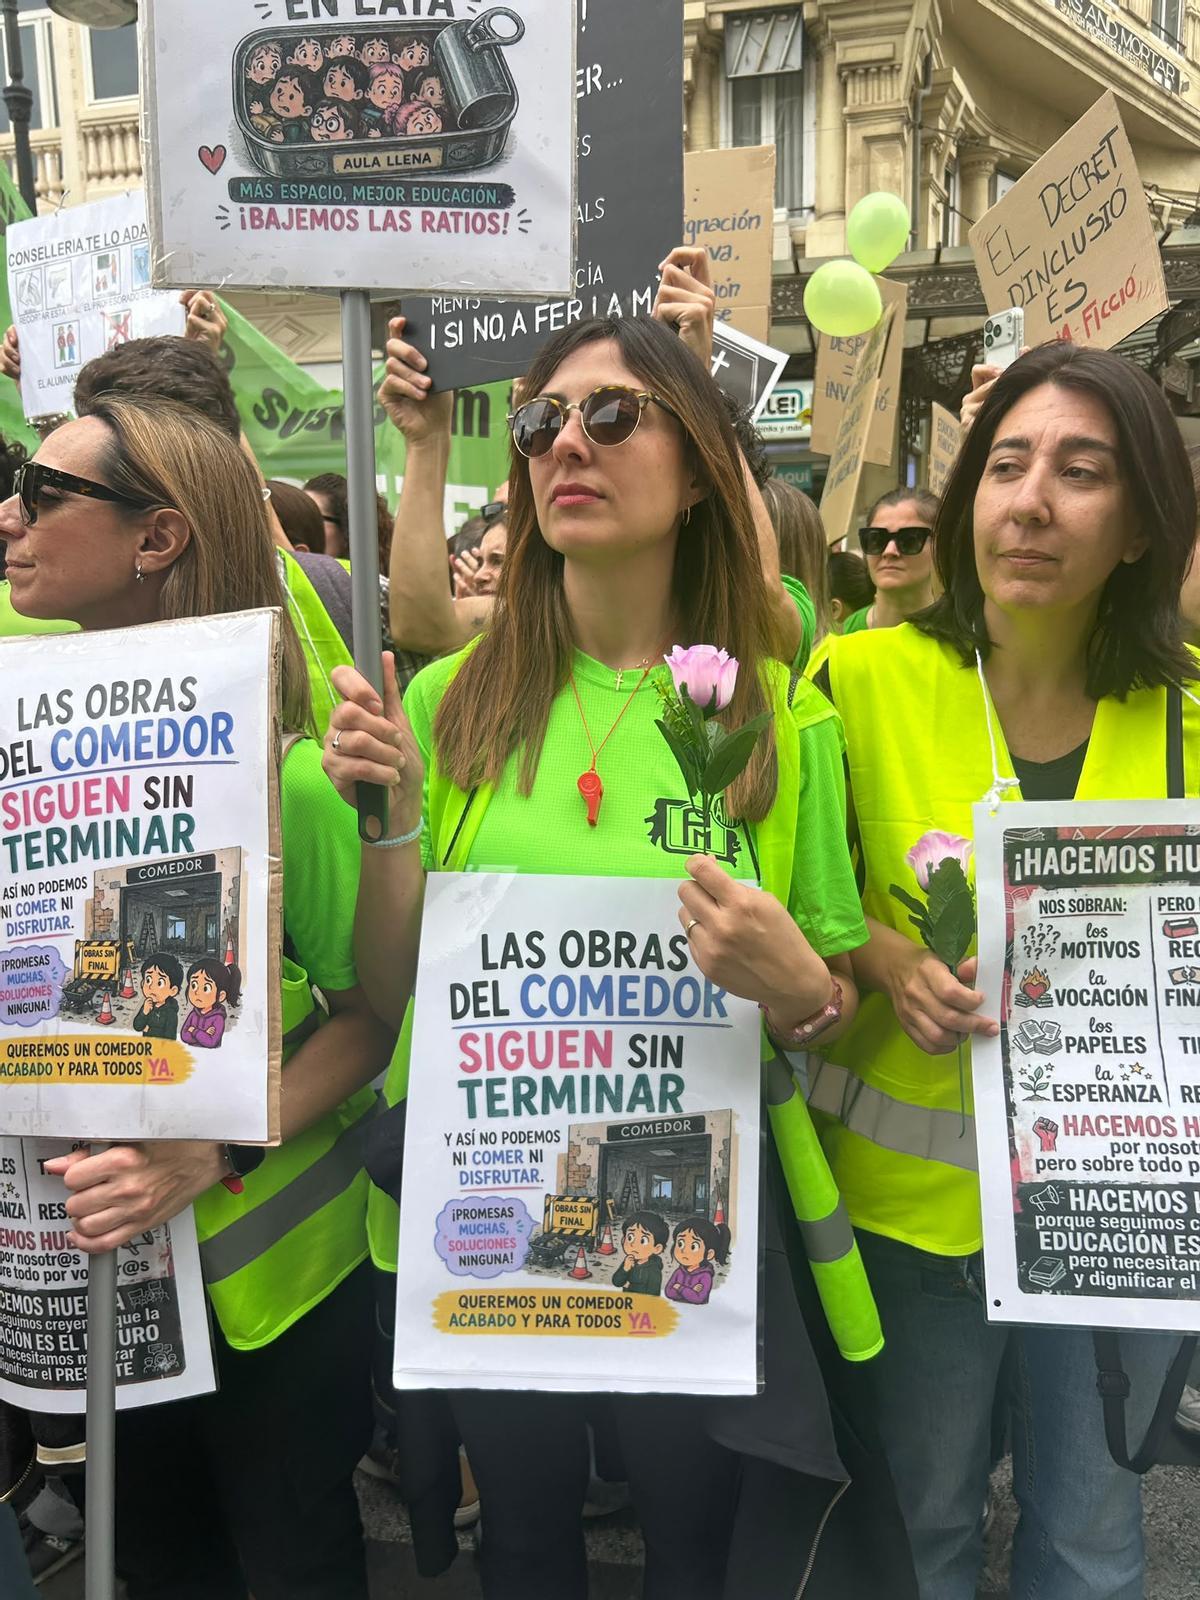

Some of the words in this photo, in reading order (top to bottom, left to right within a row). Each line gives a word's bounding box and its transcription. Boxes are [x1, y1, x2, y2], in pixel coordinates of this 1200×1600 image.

[286, 0, 339, 20] EN
[1085, 3, 1118, 39] AND
[1121, 27, 1175, 82] MORTAR
[343, 155, 380, 169] AULA
[387, 152, 431, 166] LLENA
[240, 182, 274, 199] MÁS
[281, 184, 346, 203] ESPACIO,
[353, 187, 405, 202] MEJOR
[412, 186, 501, 204] EDUCACIÓN.
[986, 225, 1031, 276] EL
[1039, 125, 1118, 228] DECRET
[240, 207, 359, 232] ¡BAJEMOS
[369, 209, 412, 233] LAS
[421, 211, 510, 234] RATIOS!
[104, 231, 120, 245] LO
[430, 324, 436, 350] I
[444, 319, 463, 348] SI
[473, 313, 507, 343] NO,
[511, 309, 527, 336] A
[535, 300, 582, 333] FER
[18, 689, 74, 732] LAS
[85, 676, 198, 720] OBRAS
[50, 711, 235, 772] COMEDOR
[1, 775, 131, 831] SIGUEN
[143, 775, 194, 811] SIN
[2, 812, 196, 873] TERMINAR
[138, 859, 203, 880] COMEDOR
[1015, 844, 1156, 881] ¡HACEMOS
[3, 880, 18, 898] ASÍ
[21, 881, 35, 897] NO
[38, 876, 88, 895] PODEMOS
[1, 904, 12, 919] NI
[16, 898, 57, 917] COMER
[61, 896, 74, 911] NI
[1039, 899, 1066, 914] NOS
[1068, 898, 1127, 913] SOBRAN:
[1158, 897, 1195, 912] PERO
[6, 917, 75, 937] DISFRUTAR.
[1086, 922, 1108, 938] los
[83, 949, 102, 959] OBRAS
[103, 949, 115, 959] SIN
[481, 930, 546, 971] LAS
[559, 929, 688, 971] OBRAS
[1061, 941, 1140, 959] MOTIVOS
[1, 954, 50, 973] ¡PROMESAS
[88, 960, 109, 972] FINAL
[7, 972, 47, 987] MUCHAS,
[1089, 969, 1107, 986] la
[0, 984, 53, 1001] SOLUCIONES
[450, 979, 510, 1020] DEL
[519, 974, 728, 1019] COMEDOR
[1055, 984, 1149, 1007] VOCACIÓN
[7, 1000, 50, 1017] NINGUNA!
[1089, 1017, 1113, 1033] los
[7, 1042, 70, 1058] QUEREMOS
[74, 1042, 91, 1056] UN
[95, 1041, 153, 1056] COMEDOR
[459, 1029, 613, 1073] SIGUEN
[627, 1034, 684, 1070] SIN
[1065, 1036, 1147, 1054] PAPELES
[0, 1062, 53, 1077] ACABADO
[56, 1062, 65, 1076] Y
[68, 1061, 99, 1076] PARA
[102, 1061, 143, 1076] TODOS
[147, 1058, 175, 1077] YA.
[1095, 1065, 1114, 1081] la
[458, 1073, 686, 1119] TERMINAR
[1052, 1084, 1163, 1103] ESPERANZA
[621, 1119, 692, 1138] COMEDOR
[1063, 1115, 1178, 1138] HACEMOS
[444, 1133, 453, 1146] Y
[456, 1128, 477, 1145] ASÍ
[479, 1131, 498, 1145] NO
[502, 1130, 561, 1144] PODEMOS
[453, 1151, 467, 1166] NI
[472, 1149, 523, 1165] COMER
[529, 1149, 543, 1163] NI
[1110, 1142, 1140, 1158] por
[1035, 1158, 1077, 1174] pero
[1082, 1157, 1134, 1173] sobre
[1140, 1157, 1183, 1173] todo
[459, 1169, 544, 1186] DISFRUTAR.
[554, 1204, 578, 1214] OBRAS
[580, 1205, 592, 1214] SIN
[1069, 1189, 1188, 1213] HACEMOS
[452, 1206, 514, 1222] ¡PROMESAS
[560, 1216, 585, 1227] FINAL
[458, 1222, 509, 1237] MUCHAS,
[1035, 1214, 1096, 1231] porque
[1100, 1214, 1186, 1233] seguimos
[448, 1237, 516, 1251] SOLUCIONES
[1039, 1229, 1168, 1255] EDUCACIÓN
[17, 1252, 80, 1268] nosotr@s
[458, 1252, 514, 1267] NINGUNA!
[1069, 1255, 1108, 1270] pero
[14, 1268, 40, 1281] todo
[44, 1271, 67, 1284] por
[1074, 1274, 1084, 1289] y
[1090, 1273, 1175, 1290] dignificar
[1180, 1274, 1195, 1289] el
[458, 1295, 536, 1310] QUEREMOS
[542, 1295, 561, 1309] UN
[566, 1295, 633, 1310] COMEDOR
[145, 1307, 160, 1320] la
[449, 1314, 516, 1329] ACABADO
[522, 1315, 530, 1328] Y
[535, 1314, 569, 1329] PARA
[576, 1314, 621, 1329] TODOS
[628, 1312, 656, 1329] YA.
[35, 1333, 54, 1351] ES
[58, 1334, 79, 1351] EL
[6, 1348, 74, 1366] necesitamos
[41, 1368, 52, 1381] el
